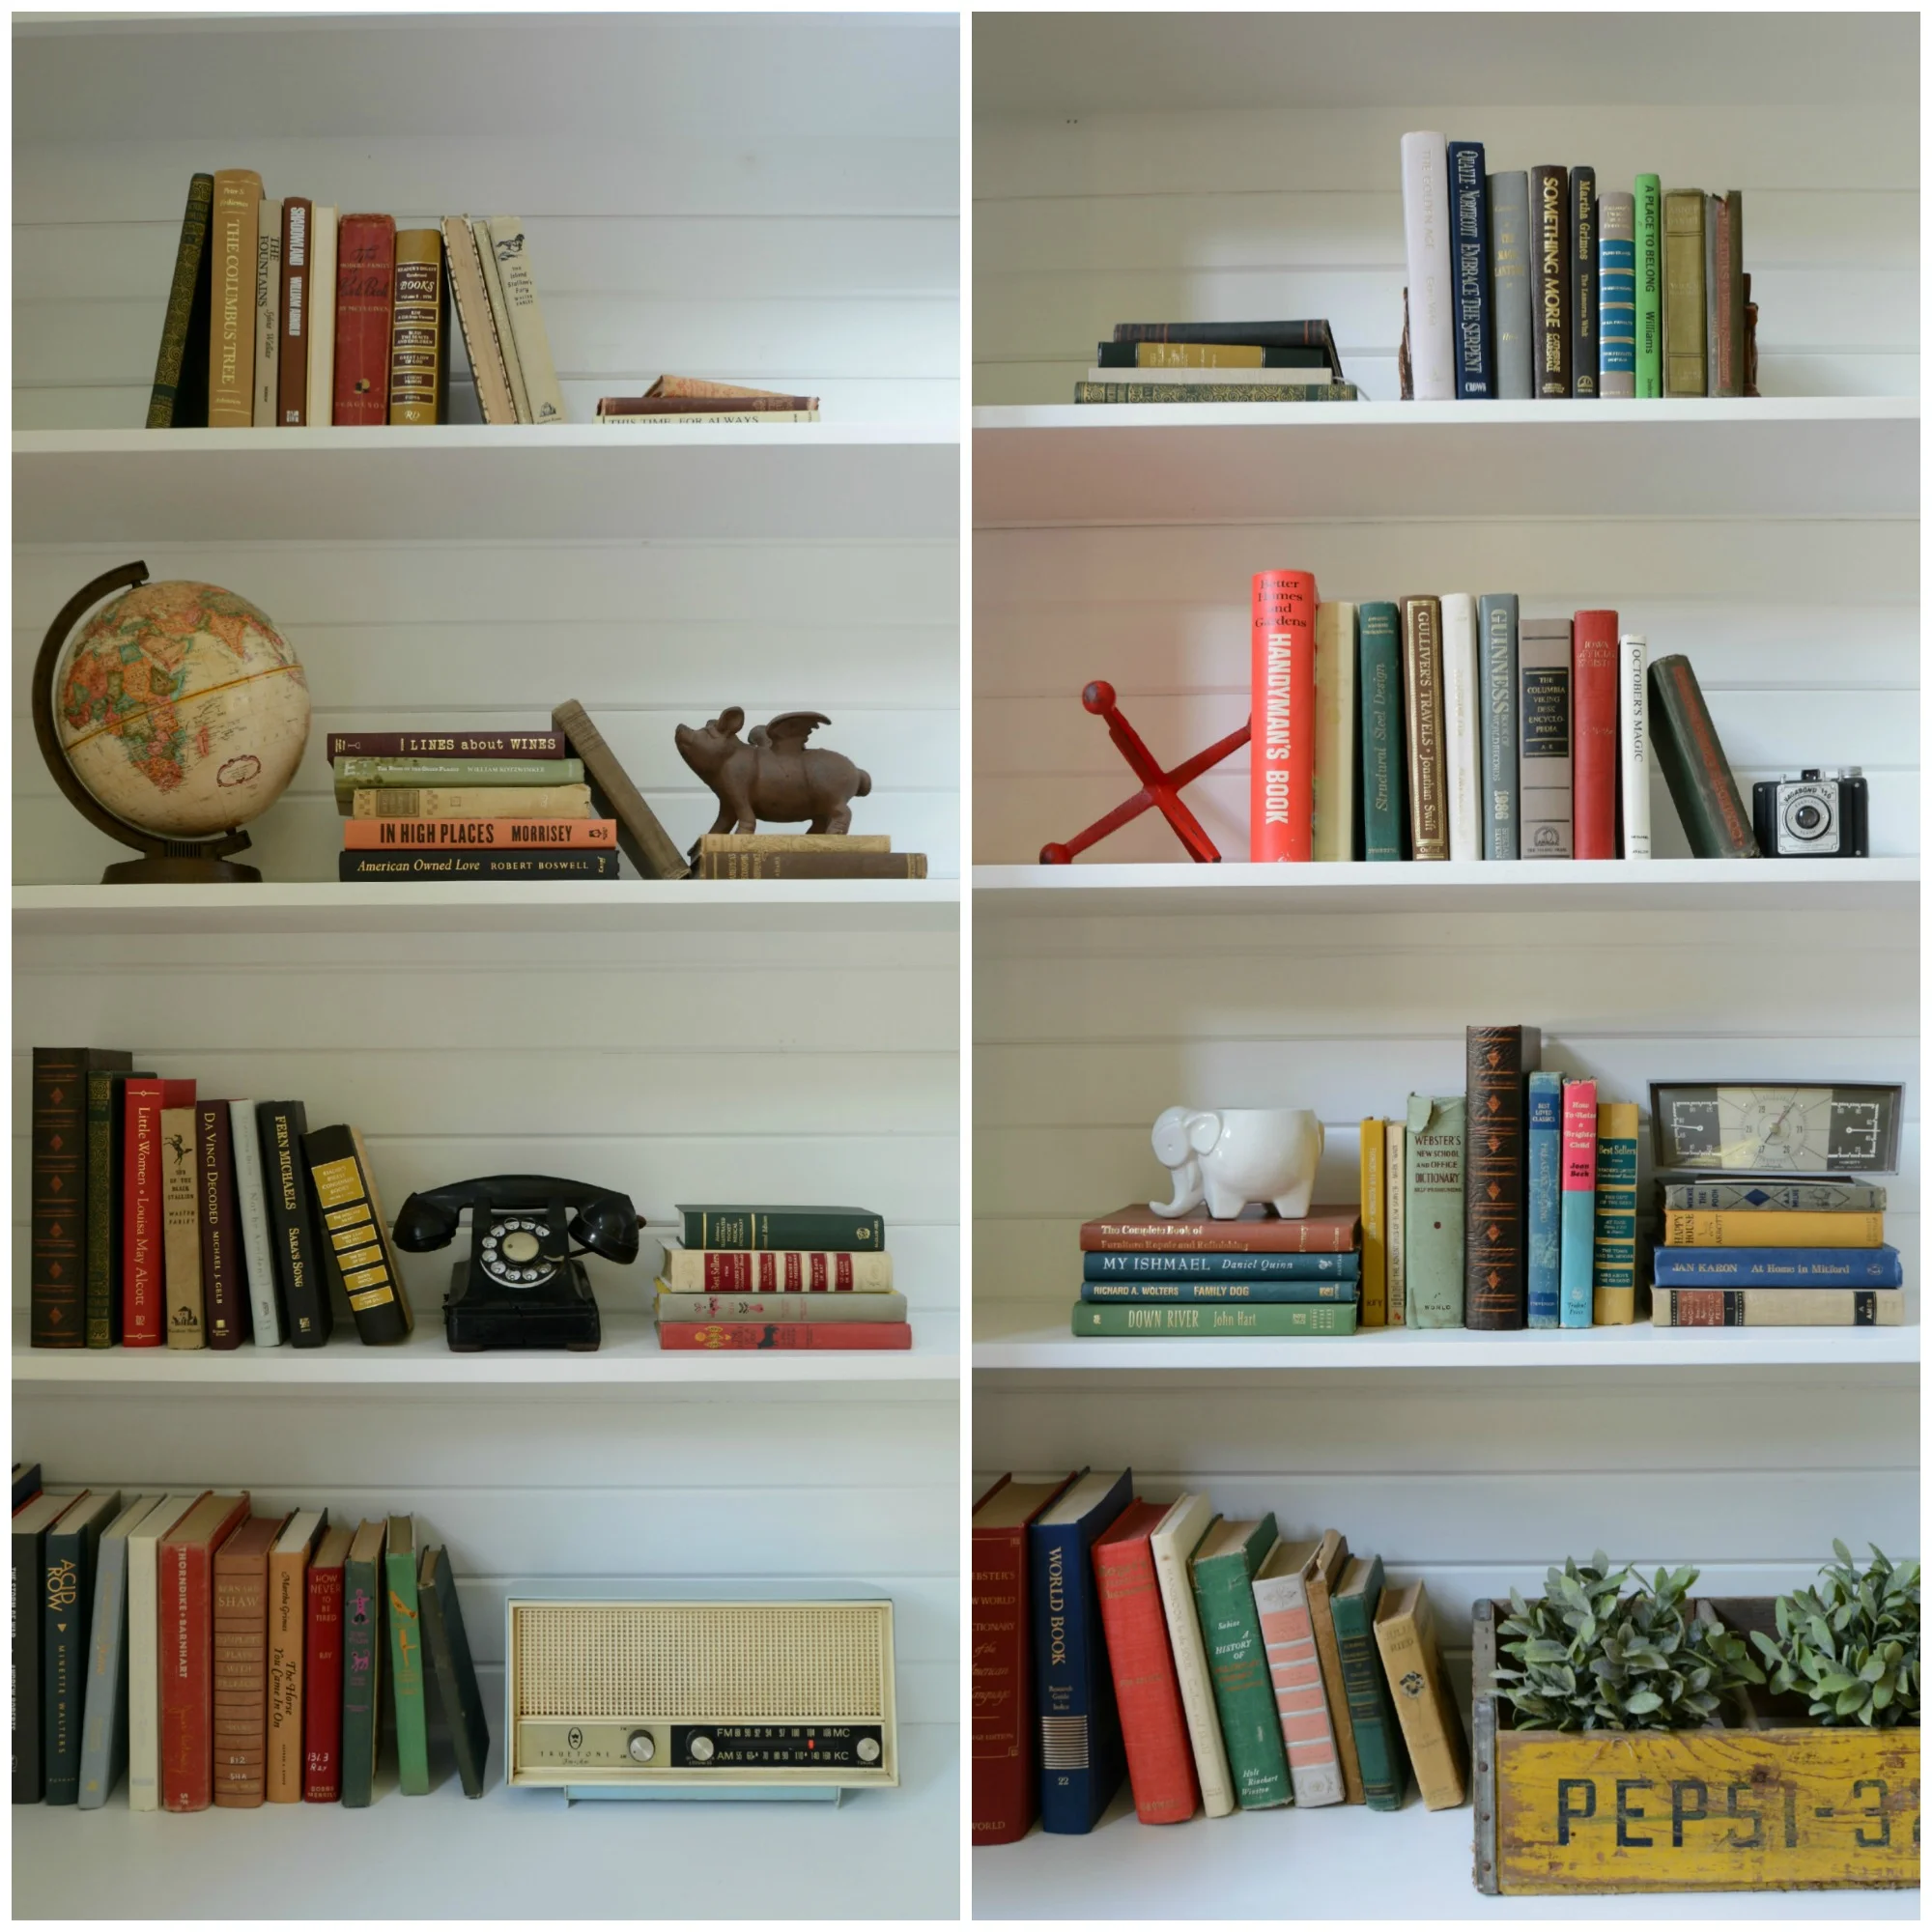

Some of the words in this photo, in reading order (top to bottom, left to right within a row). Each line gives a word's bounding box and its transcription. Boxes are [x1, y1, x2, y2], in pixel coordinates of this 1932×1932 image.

[1456, 151, 1478, 185] QUAYLE
[1579, 181, 1590, 219] Martha
[1645, 185, 1654, 193] A
[1460, 189, 1480, 238] NORTHCOTT
[1544, 177, 1559, 275] SOMETHING
[1645, 195, 1654, 229] PLACE
[227, 219, 240, 253] THE
[270, 237, 280, 262] THE
[289, 208, 305, 266] SHADOWLAND
[1579, 223, 1590, 260] Grimes
[1645, 231, 1655, 247] TO
[258, 236, 269, 307] FOUNTAINS
[1461, 243, 1481, 295] EMBRACE
[1645, 249, 1655, 293] BELONG
[224, 255, 239, 340] COLUMBUS
[400, 281, 434, 292] BOOKS
[1464, 294, 1480, 324] THE
[1546, 278, 1560, 327] MORE
[1646, 311, 1655, 354] Williams
[222, 343, 235, 384] TREE
[1464, 324, 1482, 373] SERPENT
[1465, 382, 1486, 392] CROWN
[1258, 592, 1303, 602] Homes
[1261, 579, 1299, 589] Better
[1255, 616, 1307, 628] Gardens
[1267, 604, 1292, 613] and
[1417, 611, 1434, 688] GULLIVER'S
[1491, 609, 1508, 714] GUINNESS
[1265, 633, 1292, 760] HANDYMAN'S
[1373, 664, 1386, 703] Design
[1632, 648, 1642, 717] OCTOBER'S
[1374, 708, 1386, 743] Steel
[1420, 692, 1434, 746] TRAVELS
[411, 739, 455, 751] LINES
[461, 738, 504, 751] about
[510, 738, 556, 751] WINES
[1634, 720, 1643, 763] MAGIC
[1375, 747, 1390, 811] Structural
[1419, 754, 1435, 802] Jonathan
[1265, 770, 1290, 825] BOOK
[1494, 791, 1510, 820] 1986
[1784, 787, 1817, 802] VAGABOND
[380, 823, 397, 843] IN
[401, 824, 436, 843] HIGH
[440, 824, 495, 843] PLACES
[512, 825, 573, 842] MORRISEY
[1424, 804, 1435, 831] Swift
[357, 860, 410, 872] American
[414, 859, 452, 871] Owned
[456, 859, 480, 871] Love
[491, 862, 533, 870] ROBERT
[538, 862, 589, 870] BOSWELL
[137, 1107, 150, 1140] Little
[204, 1112, 215, 1131] DA
[275, 1116, 288, 1148] FERN
[1565, 1130, 1596, 1139] Brighter
[206, 1133, 216, 1168] VINCI
[1415, 1136, 1462, 1146] WEBSTER'S
[137, 1143, 151, 1185] Women
[1415, 1173, 1461, 1183] DICTIONARY
[278, 1150, 296, 1210] MICHAELS
[207, 1171, 218, 1225] DECODED
[137, 1198, 150, 1235] Louisa
[133, 1238, 148, 1264] May
[288, 1228, 300, 1260] SARA'S
[293, 1261, 303, 1288] SONG
[1103, 1258, 1128, 1270] MY
[1134, 1259, 1210, 1271] ISHMAEL
[1222, 1260, 1257, 1269] Daniel
[1261, 1260, 1293, 1270] Quinn
[1672, 1263, 1694, 1272] JAN
[1698, 1264, 1738, 1273] KARON
[1751, 1264, 1764, 1273] At
[1767, 1264, 1795, 1273] Home
[1798, 1264, 1808, 1273] in
[1811, 1264, 1850, 1273] Mitford
[135, 1266, 149, 1306] Alcott
[1094, 1286, 1128, 1295] RICHARD
[1131, 1287, 1140, 1295] A.
[1142, 1287, 1179, 1295] WOLTERS
[1194, 1287, 1228, 1295] FAMILY
[1230, 1287, 1249, 1295] DOG
[1128, 1310, 1162, 1327] DOWN
[1167, 1310, 1199, 1327] RIVER
[1213, 1311, 1235, 1327] John
[1237, 1311, 1257, 1326] Hart
[46, 1567, 63, 1611] ROW
[60, 1558, 76, 1605] ACID
[177, 1547, 186, 1611] THORNDIKE
[281, 1572, 290, 1603] Martha
[310, 1584, 341, 1594] NEVER
[316, 1575, 338, 1583] HOW
[1048, 1547, 1064, 1612] WORLD
[1217, 1619, 1240, 1630] Sabine
[179, 1620, 187, 1678] BARNHART
[1051, 1616, 1065, 1665] BOOK
[1215, 1640, 1252, 1655] HISTORY
[1234, 1651, 1245, 1660] OF
[273, 1647, 283, 1670] You
[286, 1662, 297, 1682] The
[272, 1669, 283, 1696] Came
[274, 1699, 283, 1709] In
[285, 1683, 297, 1716] Horse
[273, 1713, 283, 1728] On
[717, 1729, 733, 1738] FM
[833, 1728, 850, 1738] MC
[717, 1751, 734, 1760] AM
[835, 1751, 849, 1761] KC
[1058, 1776, 1069, 1785] 22
[1243, 1769, 1260, 1777] Holt
[1248, 1776, 1278, 1785] Rinehart
[1242, 1786, 1269, 1796] Winston
